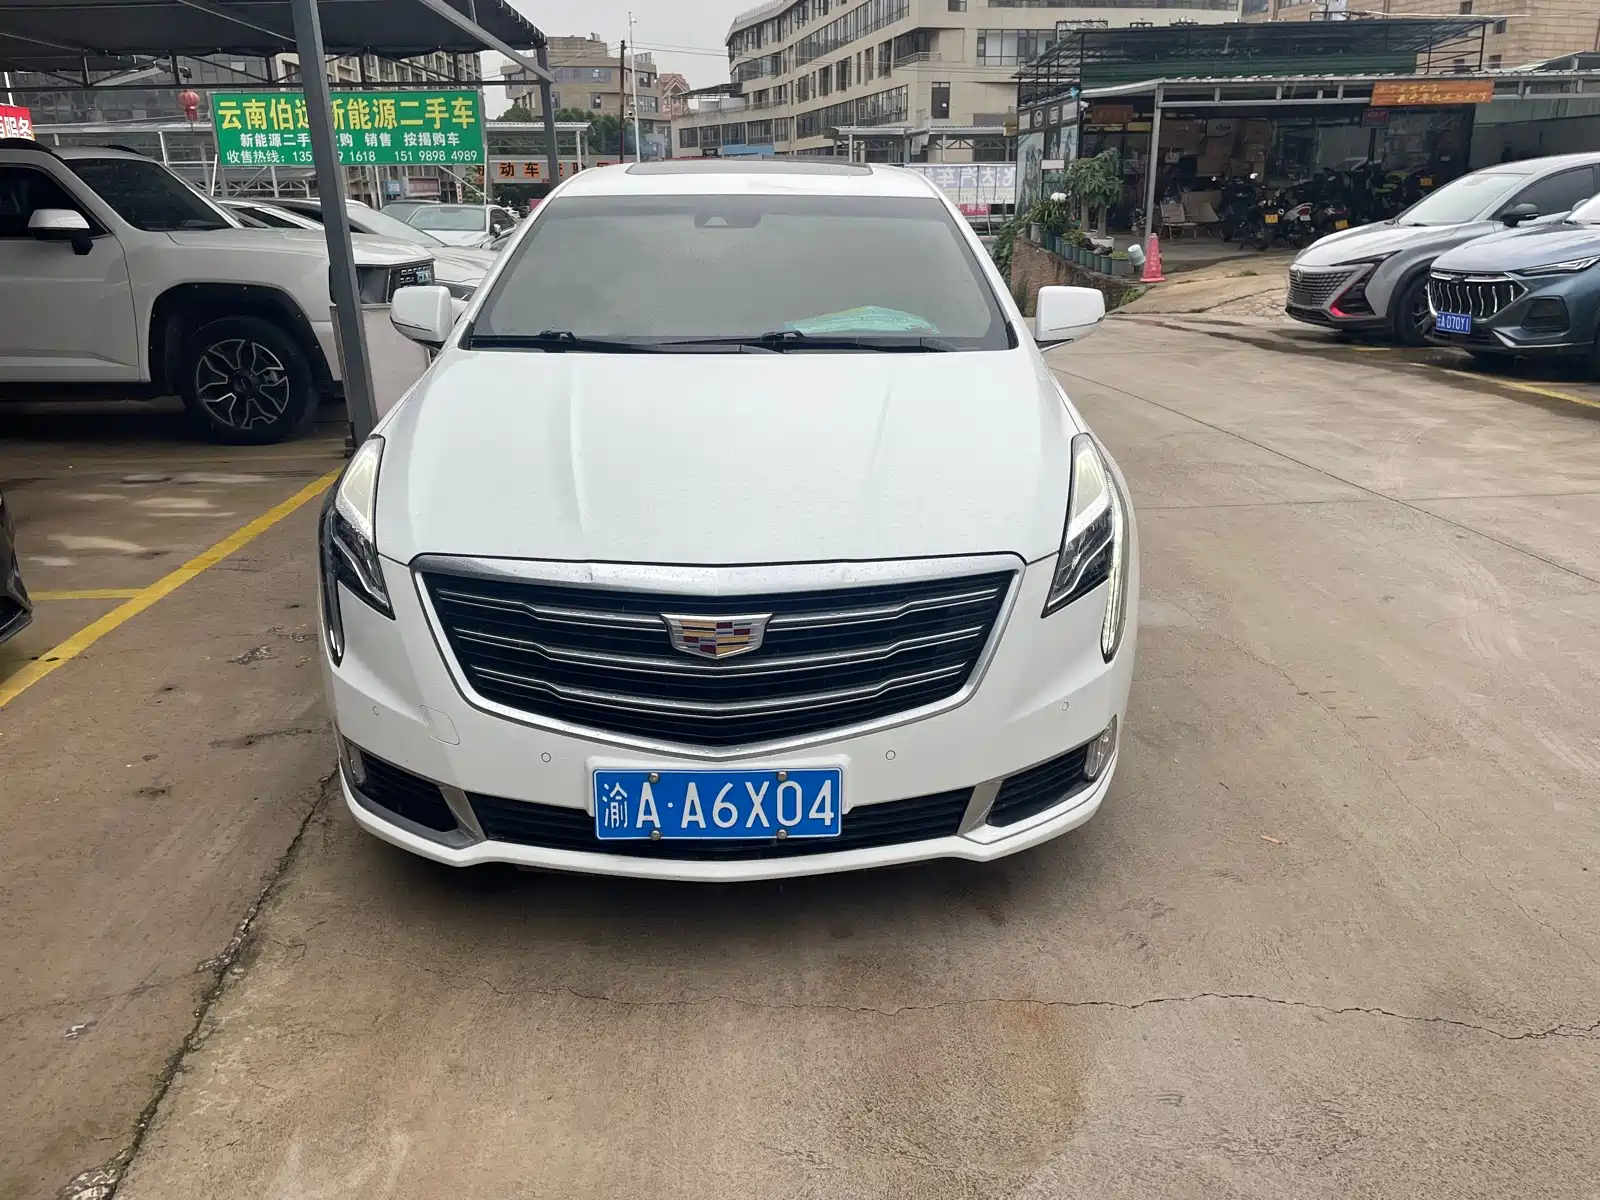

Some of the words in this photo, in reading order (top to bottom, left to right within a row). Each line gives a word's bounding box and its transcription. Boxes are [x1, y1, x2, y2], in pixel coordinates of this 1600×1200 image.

[240, 132, 353, 147] 新能源二手购
[365, 132, 392, 147] 销售
[403, 132, 460, 146] 按揭购车
[349, 151, 376, 162] 1618
[394, 151, 413, 162] 151
[418, 150, 446, 162] 9898
[451, 150, 477, 162] 4989
[602, 779, 835, 829] 渝A·A6X04
